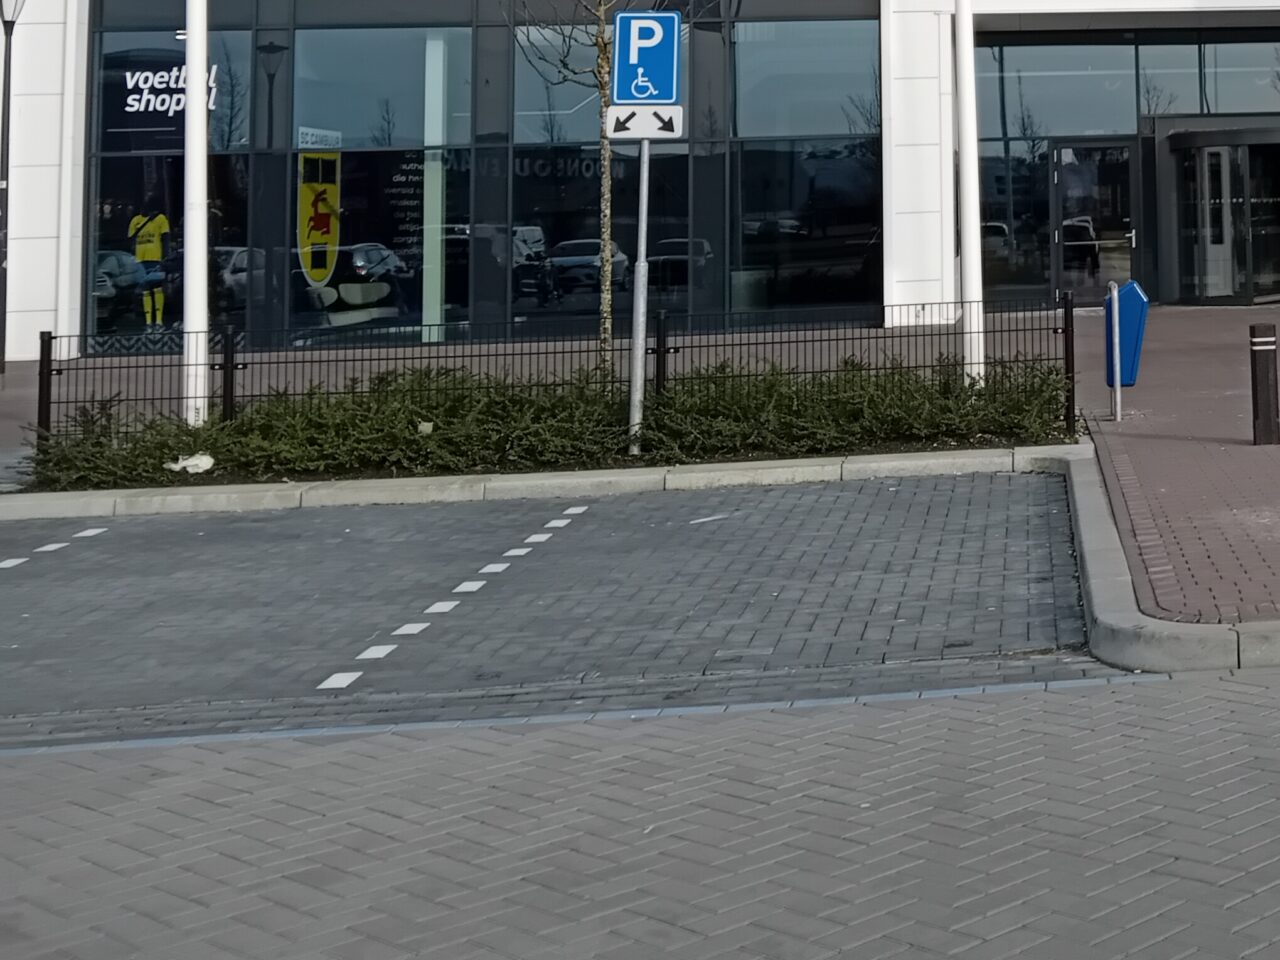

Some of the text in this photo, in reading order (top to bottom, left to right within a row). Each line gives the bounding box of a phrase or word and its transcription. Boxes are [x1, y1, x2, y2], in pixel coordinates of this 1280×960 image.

[629, 19, 664, 65] P
[125, 64, 217, 90] voetbl
[124, 88, 217, 117] shopl
